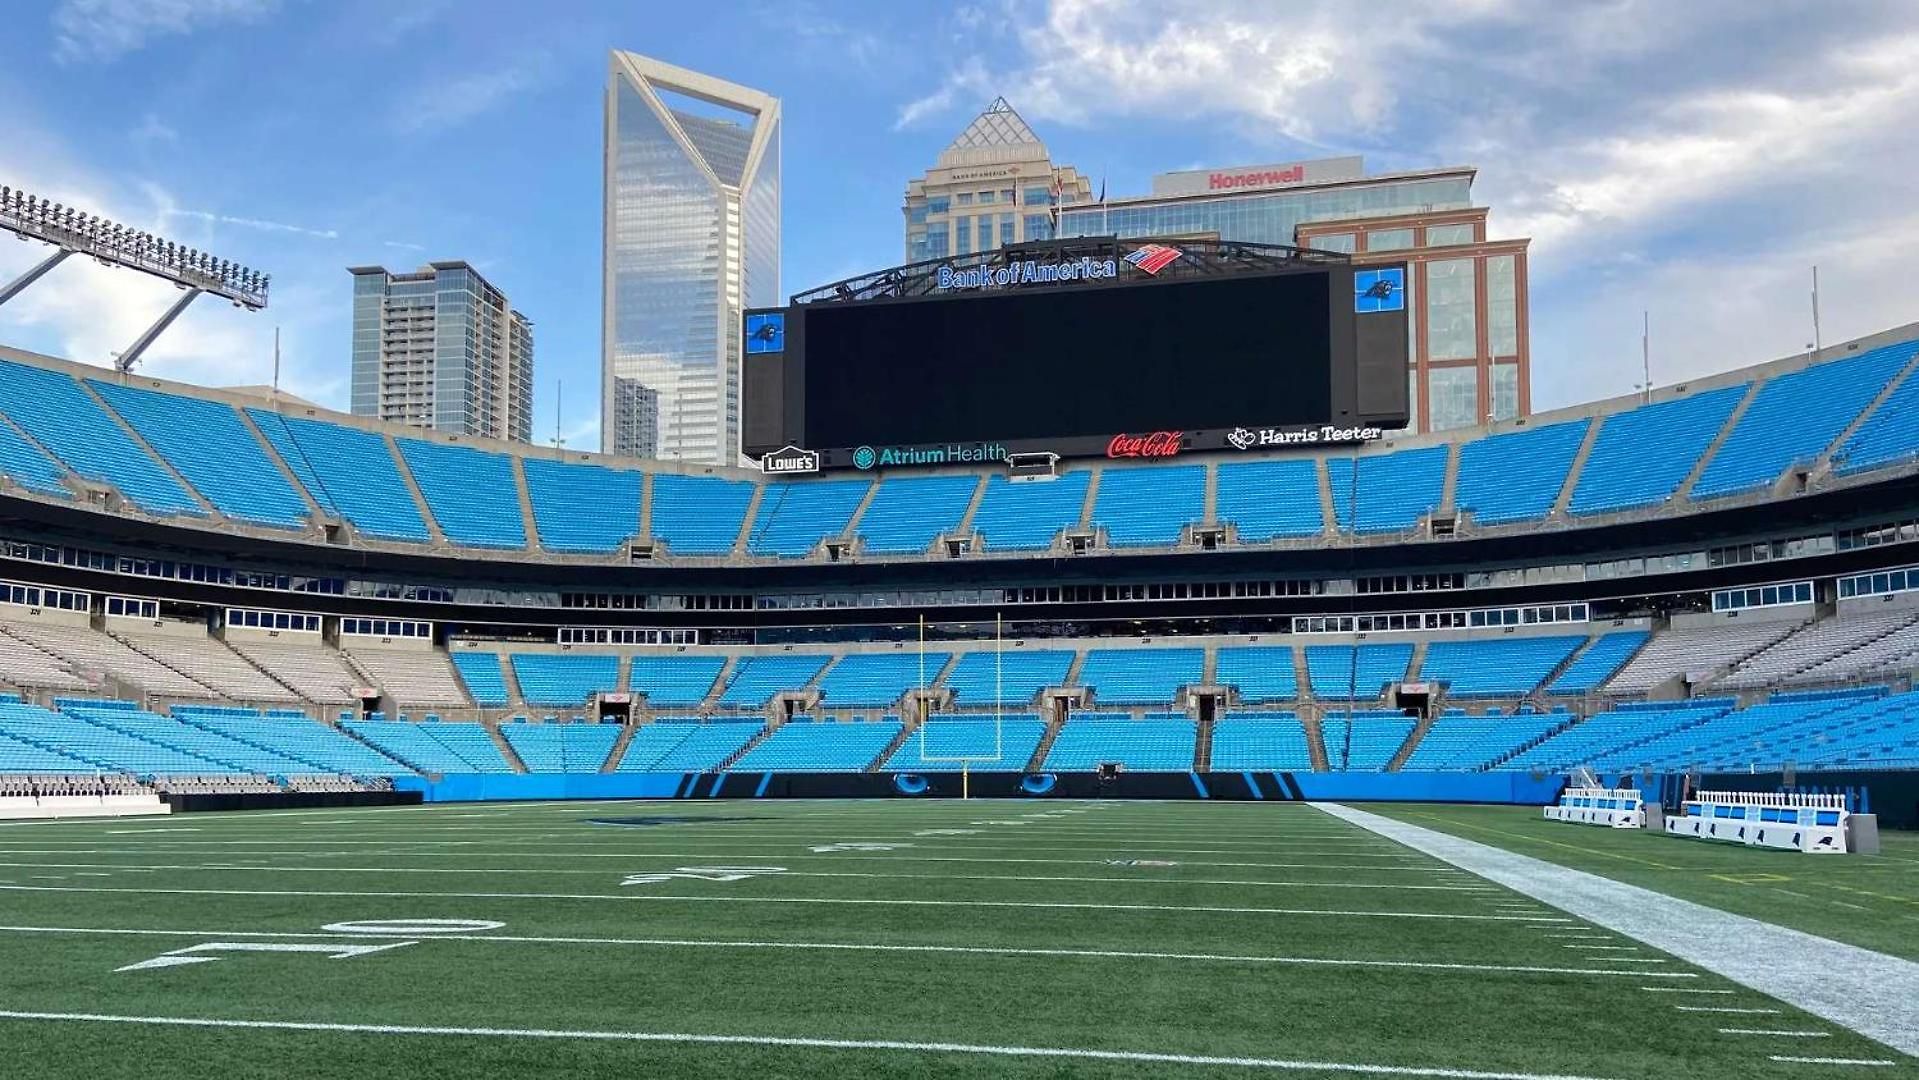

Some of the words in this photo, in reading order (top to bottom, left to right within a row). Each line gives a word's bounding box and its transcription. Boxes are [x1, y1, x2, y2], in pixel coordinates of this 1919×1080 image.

[1210, 166, 1304, 190] Honeywell
[937, 265, 995, 289] Bank
[996, 261, 1020, 286] of
[1021, 257, 1117, 284] America
[1259, 429, 1319, 445] Harris
[1321, 425, 1381, 442] Teeter
[768, 455, 814, 471] LOWE'S
[879, 447, 944, 466] Atrium
[947, 443, 1008, 463] Health
